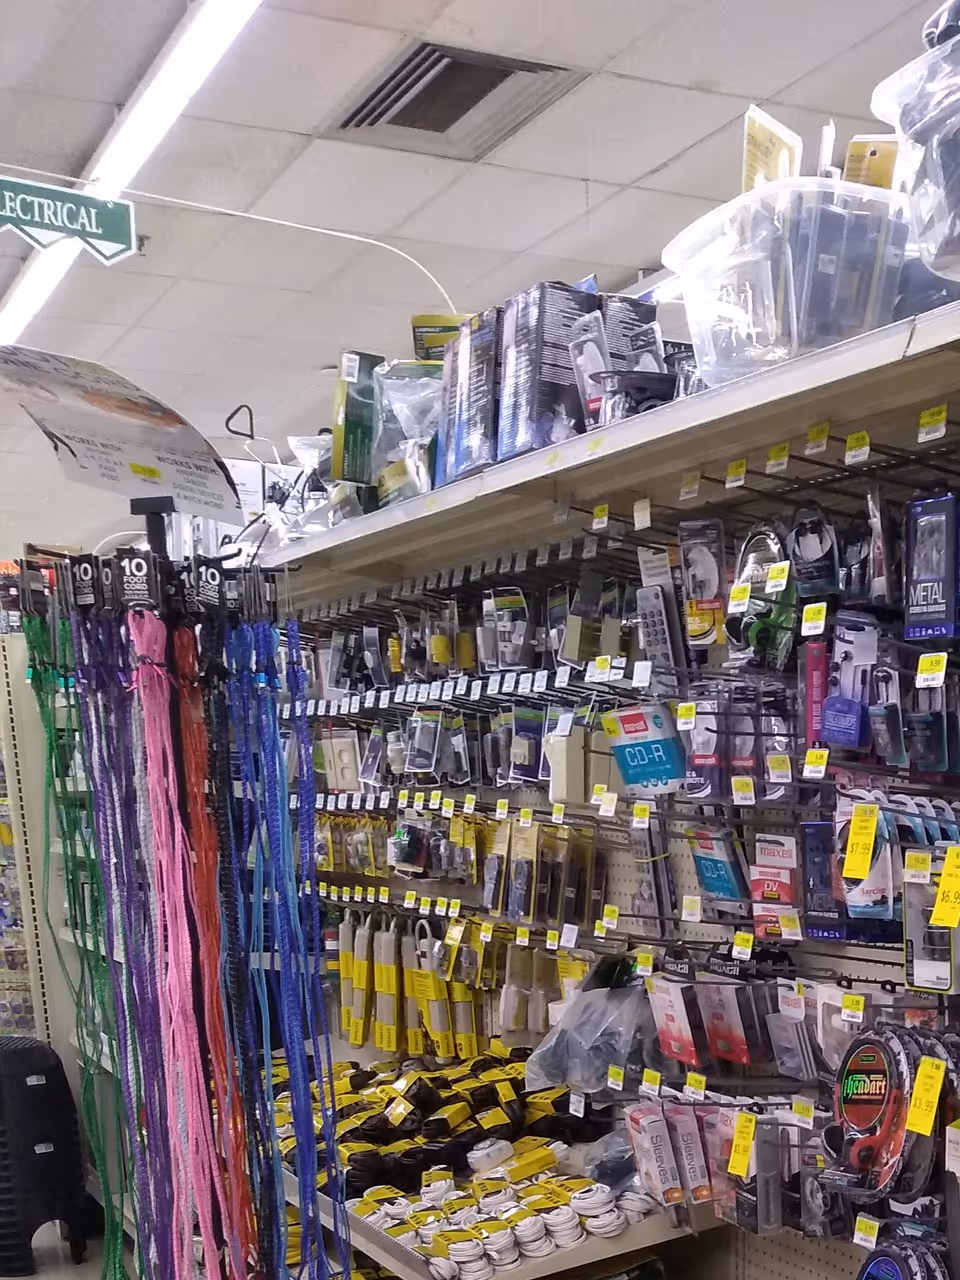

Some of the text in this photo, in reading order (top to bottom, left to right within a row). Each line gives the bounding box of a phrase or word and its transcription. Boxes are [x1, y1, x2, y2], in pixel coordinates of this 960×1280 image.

[73, 563, 92, 581] 10
[121, 558, 147, 575] 10
[199, 565, 220, 585] 10
[123, 576, 147, 584] FOOT
[909, 582, 946, 606] METAL
[625, 744, 667, 766] CD-R
[759, 846, 792, 860] maxell
[764, 880, 779, 892] DV
[912, 1097, 934, 1112] $3.99
[651, 1134, 669, 1185] Sleeves
[681, 1132, 698, 1182] Sleeves
